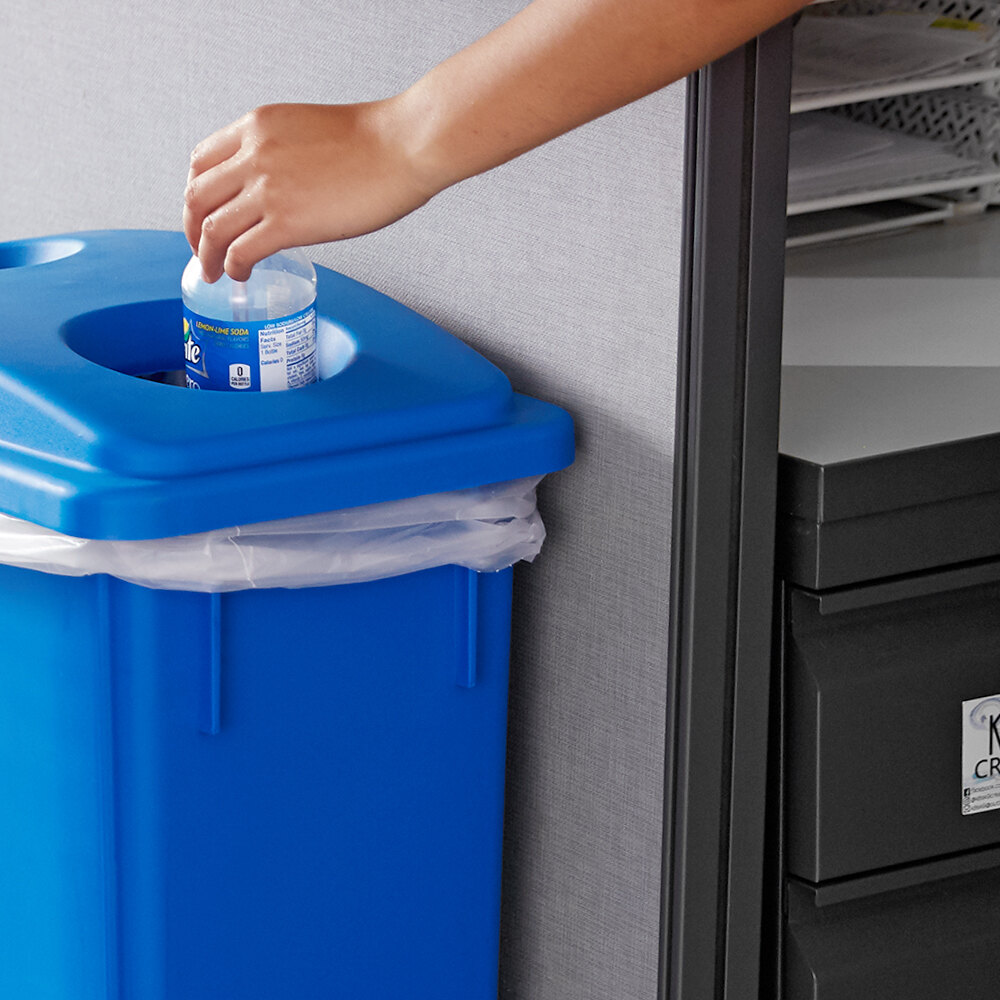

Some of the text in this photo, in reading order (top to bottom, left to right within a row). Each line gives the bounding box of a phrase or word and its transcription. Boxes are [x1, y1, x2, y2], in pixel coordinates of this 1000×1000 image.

[196, 320, 230, 336] LEMON-LIME
[230, 328, 249, 336] SODA
[260, 328, 285, 336] Nutrition
[237, 366, 243, 376] 0
